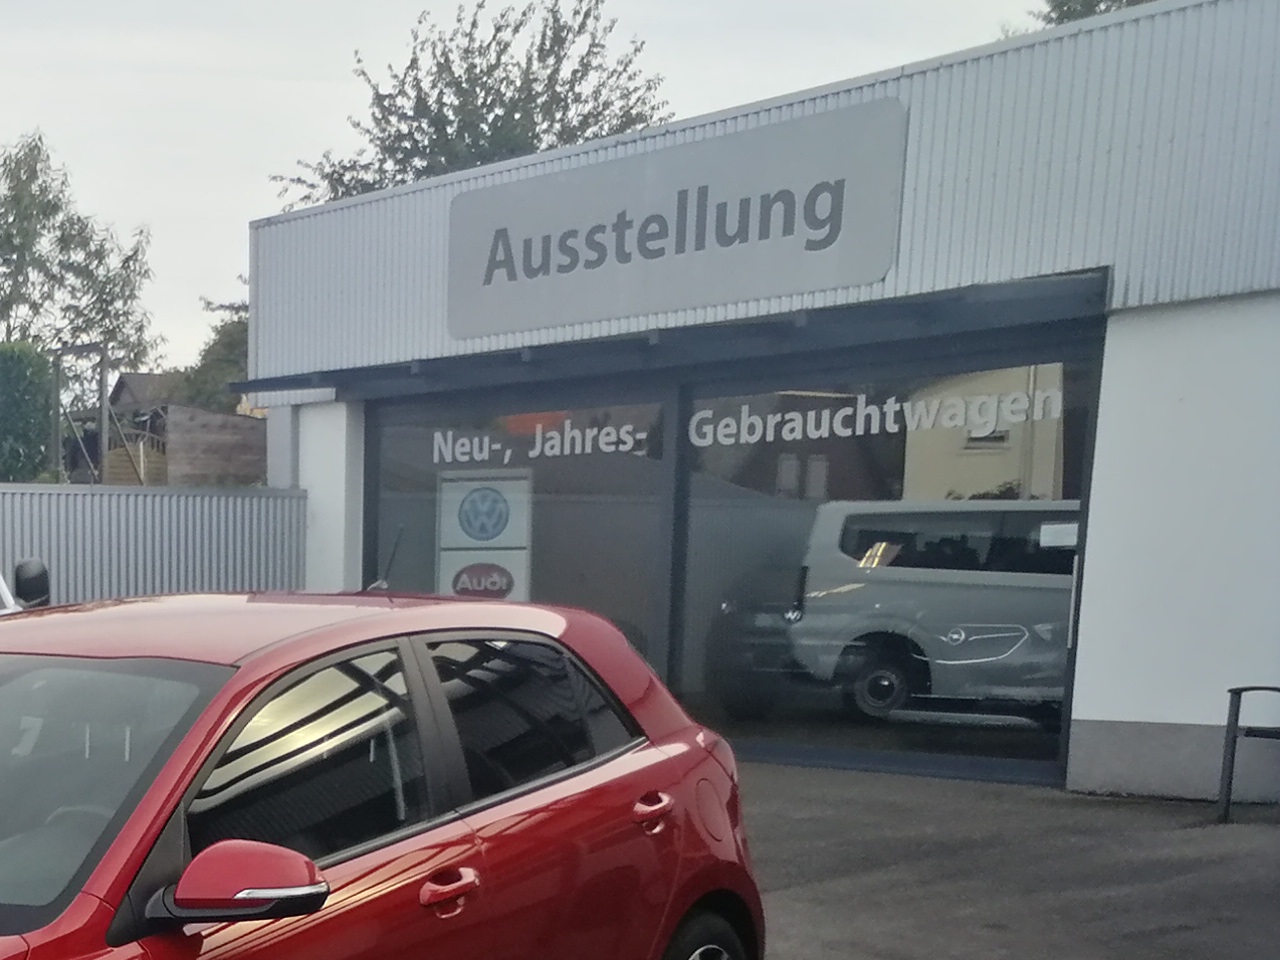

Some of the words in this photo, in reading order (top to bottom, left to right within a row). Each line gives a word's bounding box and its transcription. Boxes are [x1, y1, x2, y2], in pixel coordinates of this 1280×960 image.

[482, 178, 847, 286] Ausstellung
[432, 430, 513, 465] Neu-,
[527, 419, 648, 459] Jahres-
[688, 386, 1063, 448] Gebrauchtwagen
[459, 488, 509, 540] VW
[455, 572, 509, 591] Audi
